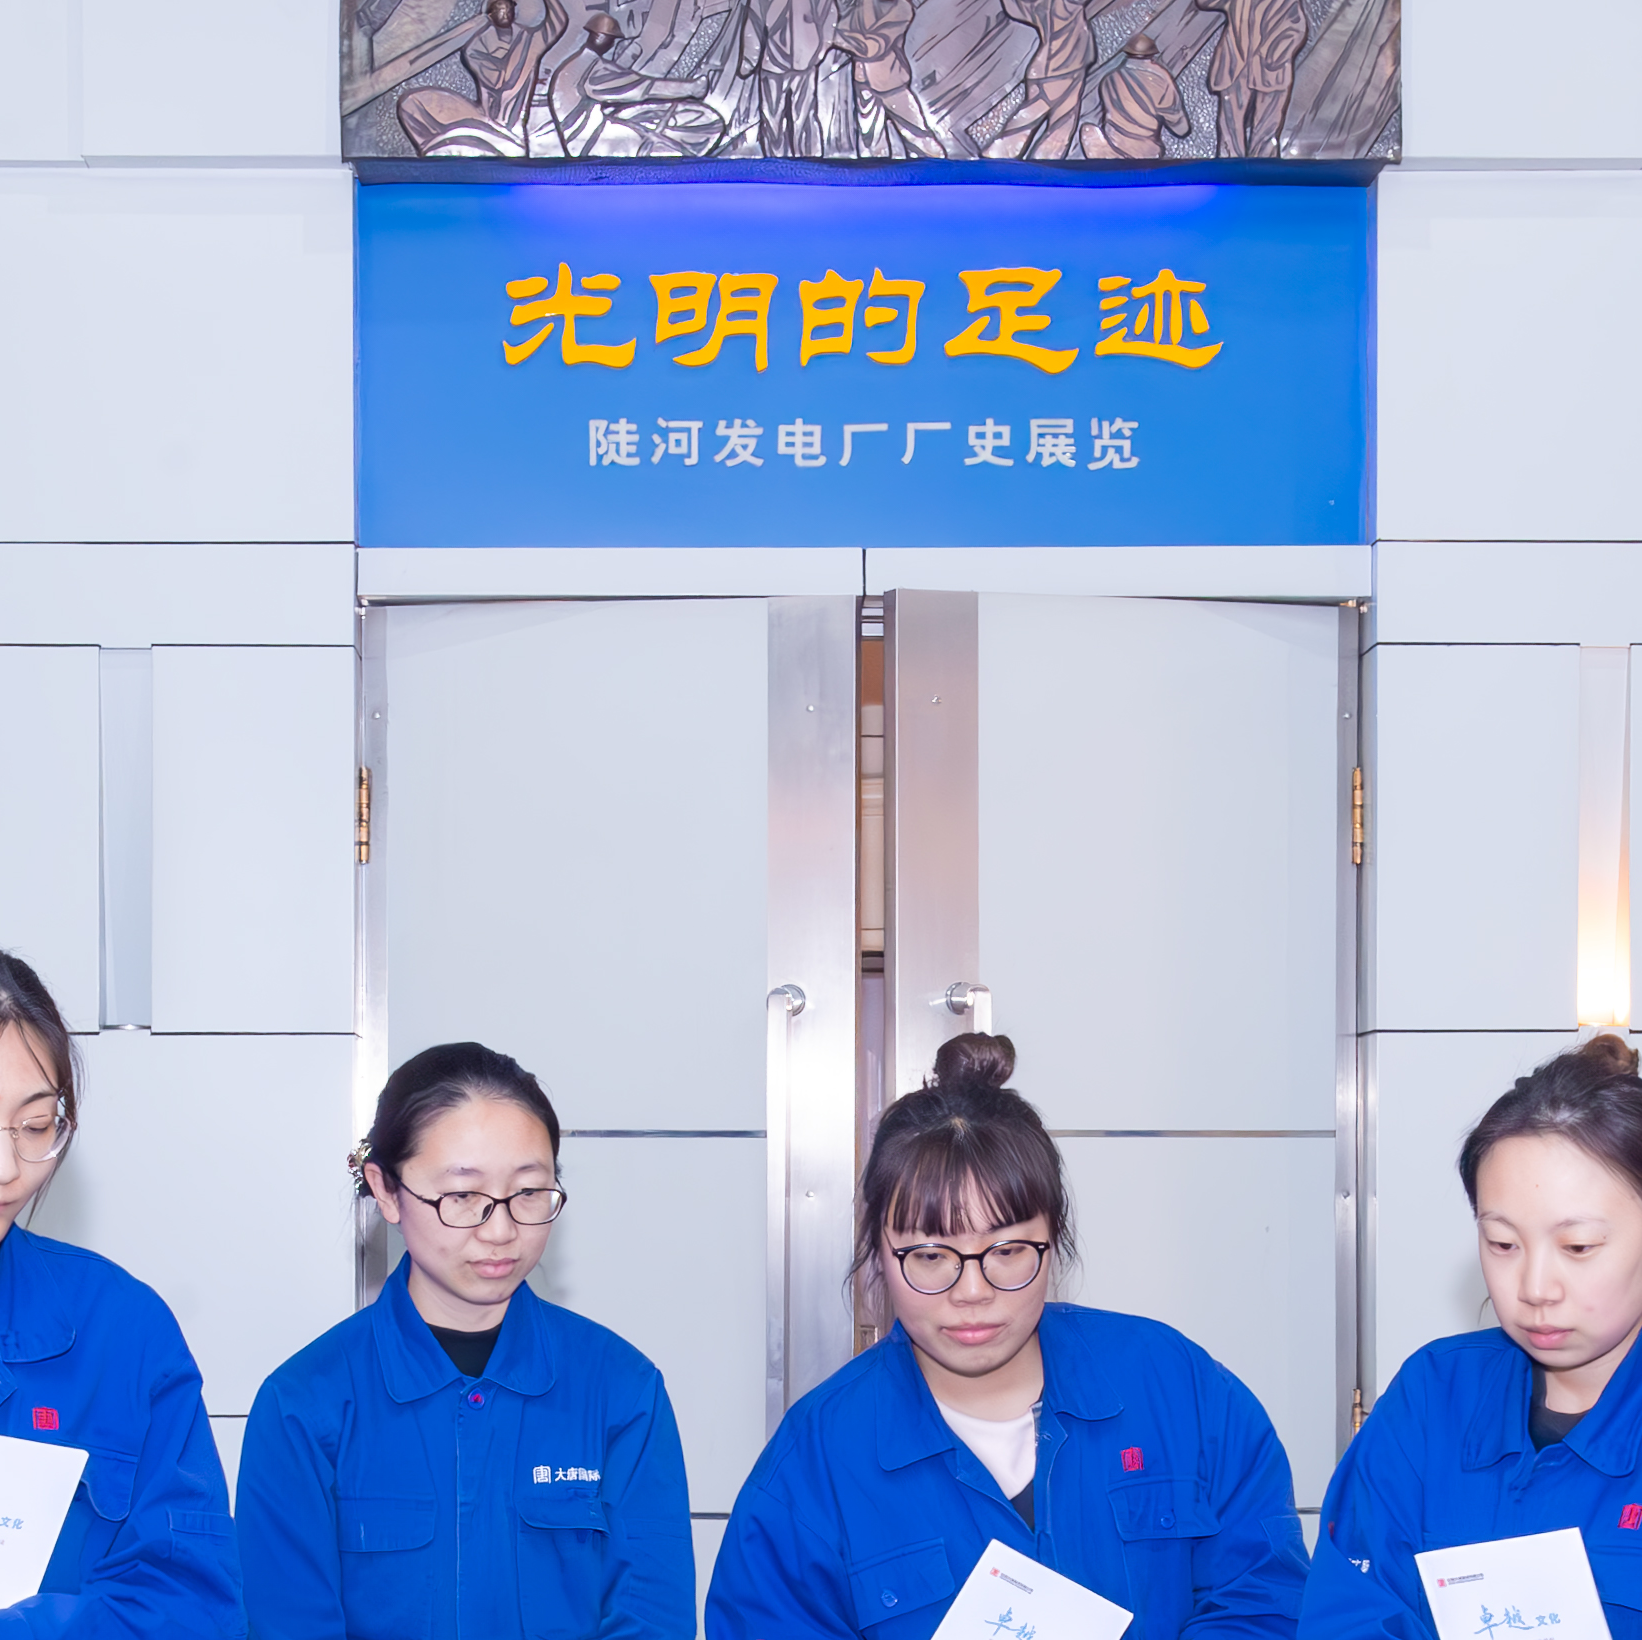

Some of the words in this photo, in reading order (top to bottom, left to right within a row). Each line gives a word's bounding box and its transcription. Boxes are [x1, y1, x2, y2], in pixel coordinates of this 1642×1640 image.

[500, 260, 1226, 375] 光明的足迹
[588, 413, 1142, 471] 陡河发电厂厂史展览
